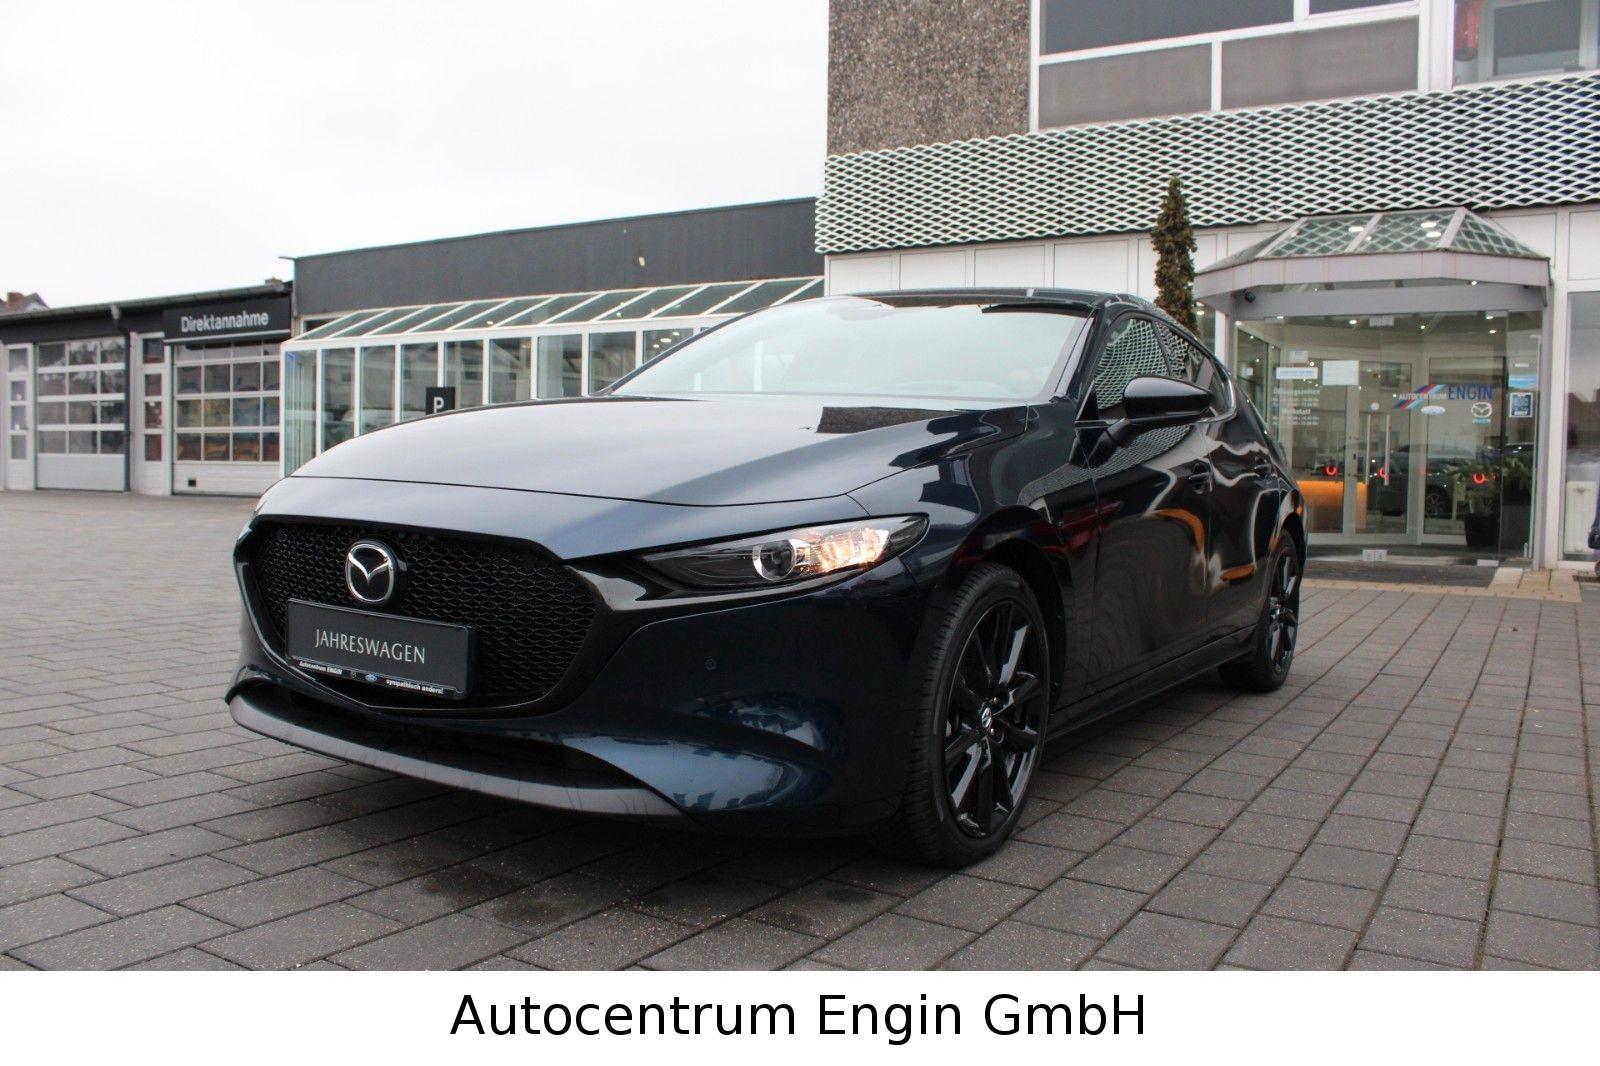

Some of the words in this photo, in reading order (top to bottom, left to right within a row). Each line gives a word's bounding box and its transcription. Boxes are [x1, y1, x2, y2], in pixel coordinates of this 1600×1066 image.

[181, 310, 269, 333] Direktannahme
[1448, 384, 1493, 400] ENGIN
[433, 396, 445, 414] P
[314, 628, 426, 665] JAHRESWAGEN
[386, 678, 421, 692] sympathisch
